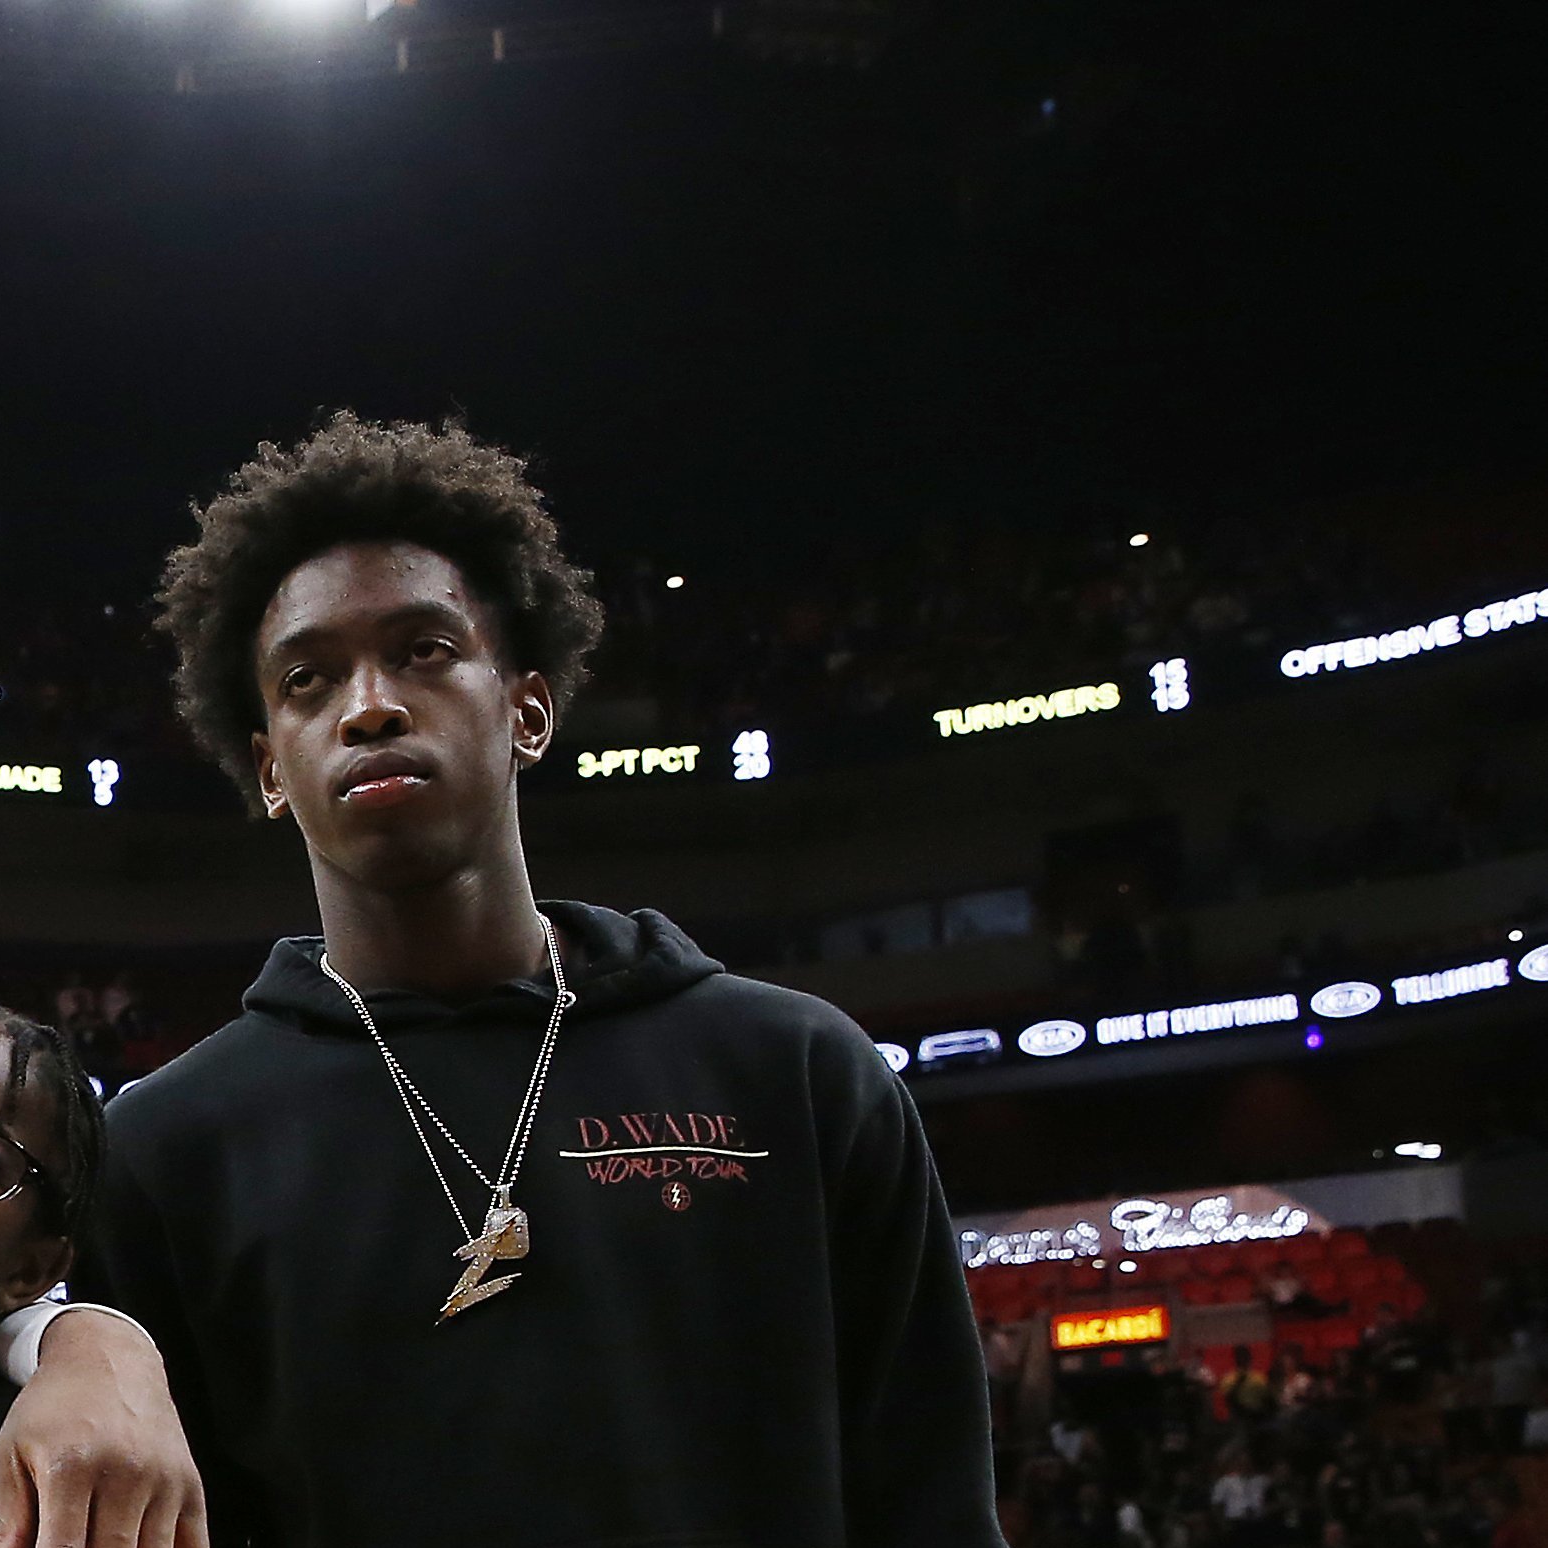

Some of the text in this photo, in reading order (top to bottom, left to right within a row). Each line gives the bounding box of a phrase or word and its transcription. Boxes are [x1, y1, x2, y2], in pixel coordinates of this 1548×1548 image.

[1280, 615, 1462, 678] OFFENSIVE
[1148, 657, 1188, 687] 15
[933, 681, 1121, 737] TURNOVERS
[577, 745, 701, 778] 3-PT PCT
[585, 1156, 749, 1185] WORLD TOUR
